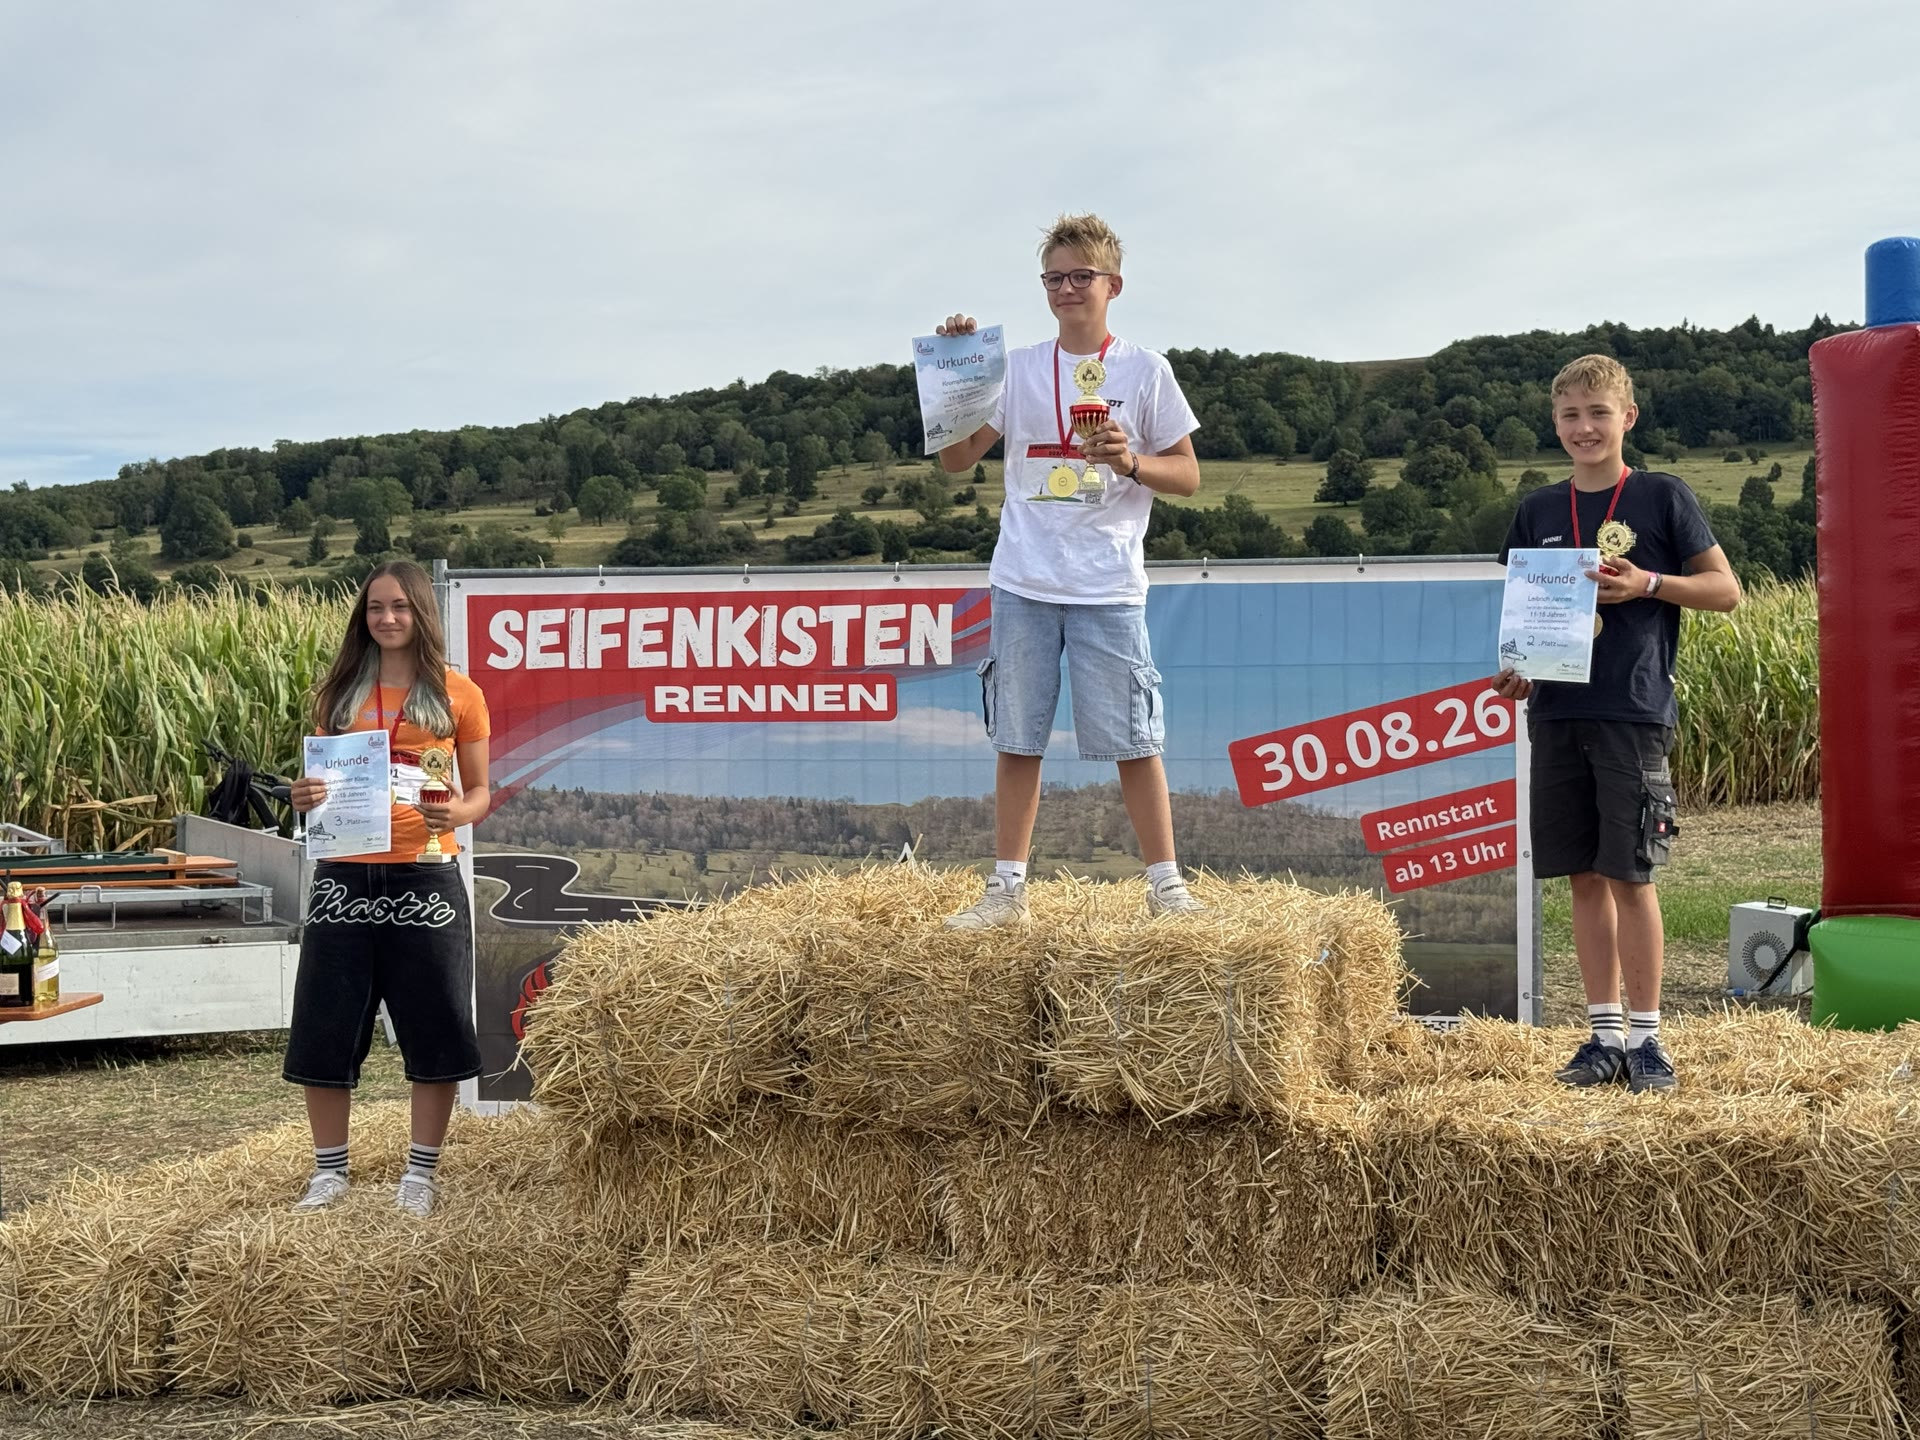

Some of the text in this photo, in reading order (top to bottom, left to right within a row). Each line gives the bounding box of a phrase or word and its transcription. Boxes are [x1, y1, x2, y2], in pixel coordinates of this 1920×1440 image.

[937, 353, 985, 370] Urkunde
[1542, 535, 1563, 546] JANNES
[1527, 573, 1576, 585] Urkunde
[486, 603, 954, 671] SEIFENKISTEN
[1526, 635, 1535, 647] 2
[654, 683, 889, 713] RENNEN
[1253, 688, 1511, 792] 30.08.26
[325, 755, 370, 769] Urkunde
[334, 815, 343, 827] 3
[1376, 797, 1498, 841] Rennstart
[1395, 840, 1507, 883] ab 13 Uhr
[305, 878, 456, 928] Chaotic
